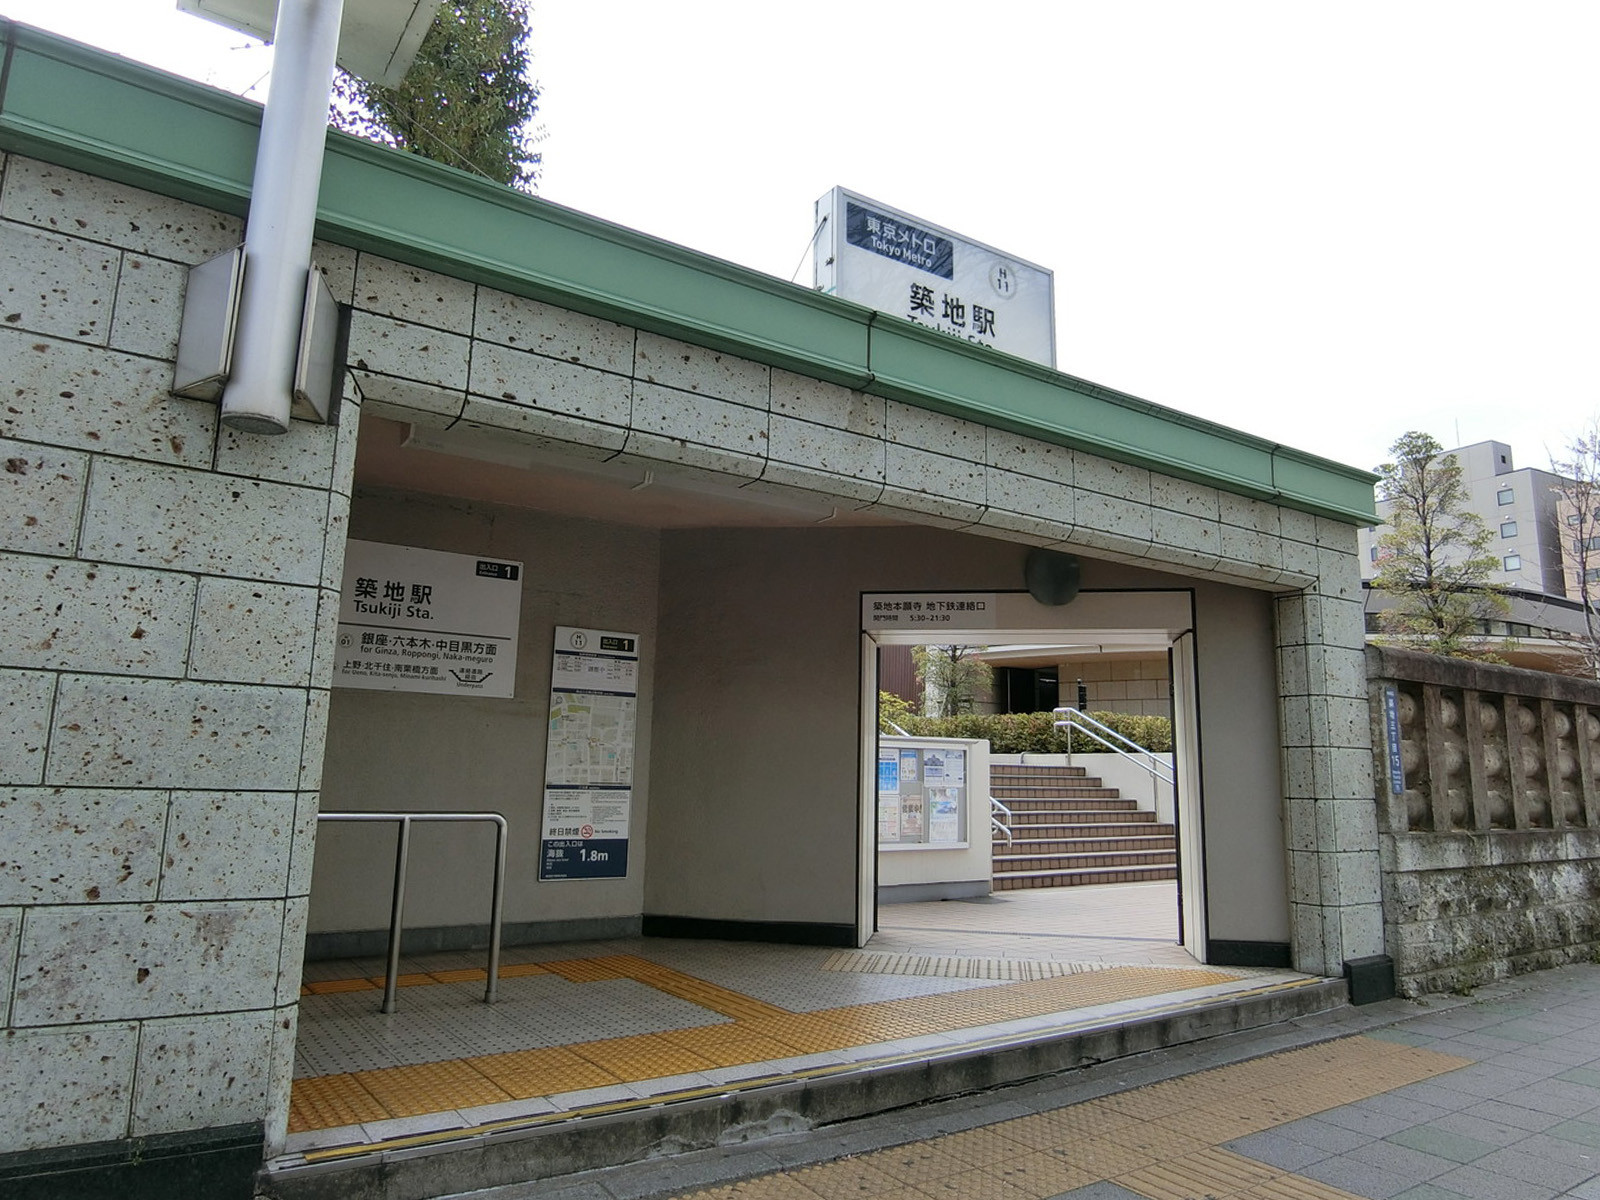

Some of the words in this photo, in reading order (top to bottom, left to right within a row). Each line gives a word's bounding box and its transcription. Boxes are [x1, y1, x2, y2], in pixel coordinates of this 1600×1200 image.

[866, 216, 936, 255] 東京メトロ
[871, 235, 901, 256] Tokyo
[903, 247, 932, 268] Metro
[999, 268, 1007, 279] H
[997, 278, 1009, 292] 11
[909, 282, 996, 338] 築地駅
[504, 566, 512, 578] 1
[354, 577, 433, 605] 築地駅
[353, 600, 401, 619] Tsukiji
[406, 605, 434, 620] Sta.
[623, 640, 629, 651] 1
[360, 645, 373, 653] for
[375, 646, 400, 656] Ginza,
[402, 648, 440, 661] Roppongi,
[443, 651, 494, 664] Naka-meguro
[1391, 755, 1400, 767] 15
[579, 848, 609, 861] 1.8m
